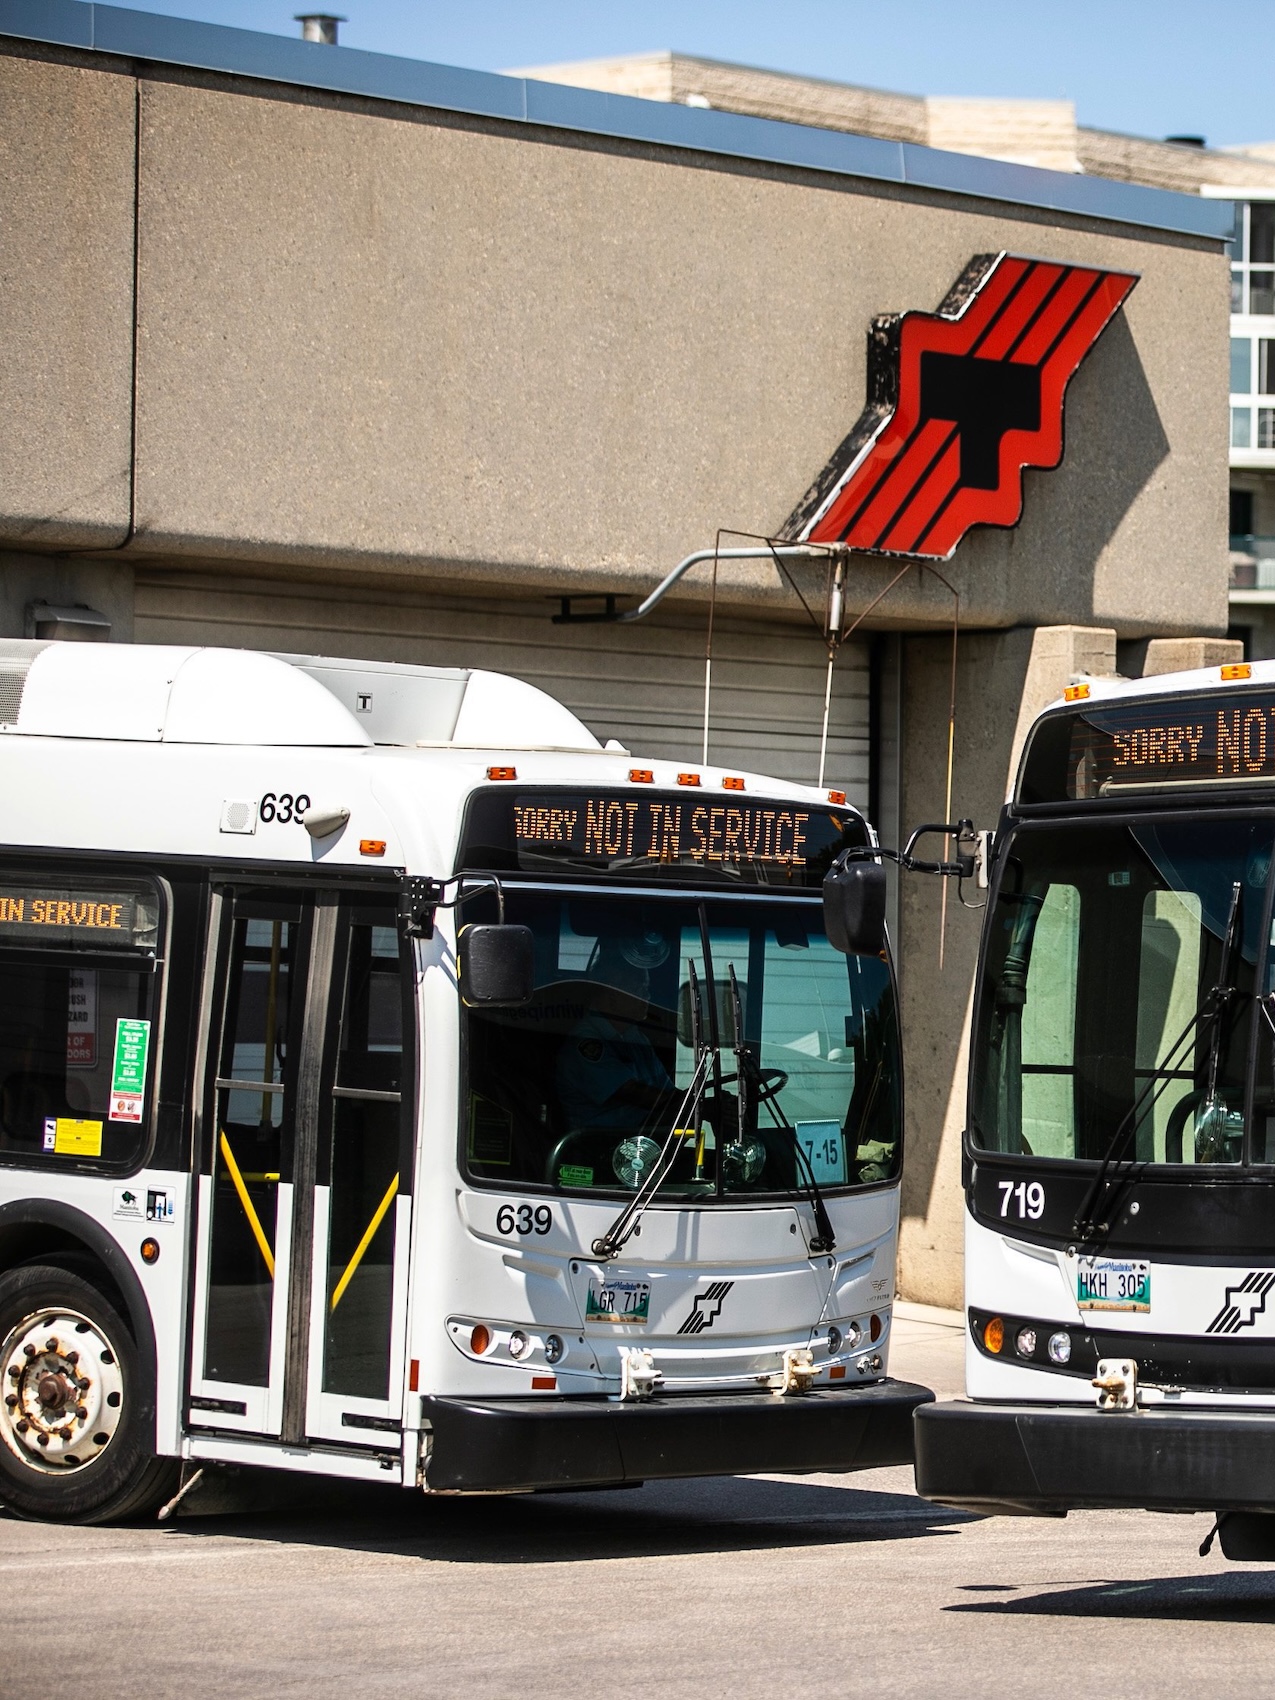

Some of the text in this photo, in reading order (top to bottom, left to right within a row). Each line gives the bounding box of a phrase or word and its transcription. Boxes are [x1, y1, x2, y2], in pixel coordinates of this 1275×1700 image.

[358, 695, 371, 709] T
[1113, 725, 1204, 766] SORRY
[259, 792, 311, 825] 639
[585, 799, 639, 856] NOT
[647, 803, 682, 858] IN
[690, 806, 809, 865] SERVICE
[0, 897, 123, 928] IN SERVICE
[805, 1139, 837, 1166] 7-15
[998, 1181, 1045, 1220] 719
[496, 1204, 552, 1236] 639
[591, 1289, 647, 1312] LGR 715
[1080, 1272, 1146, 1298] HKH 305
